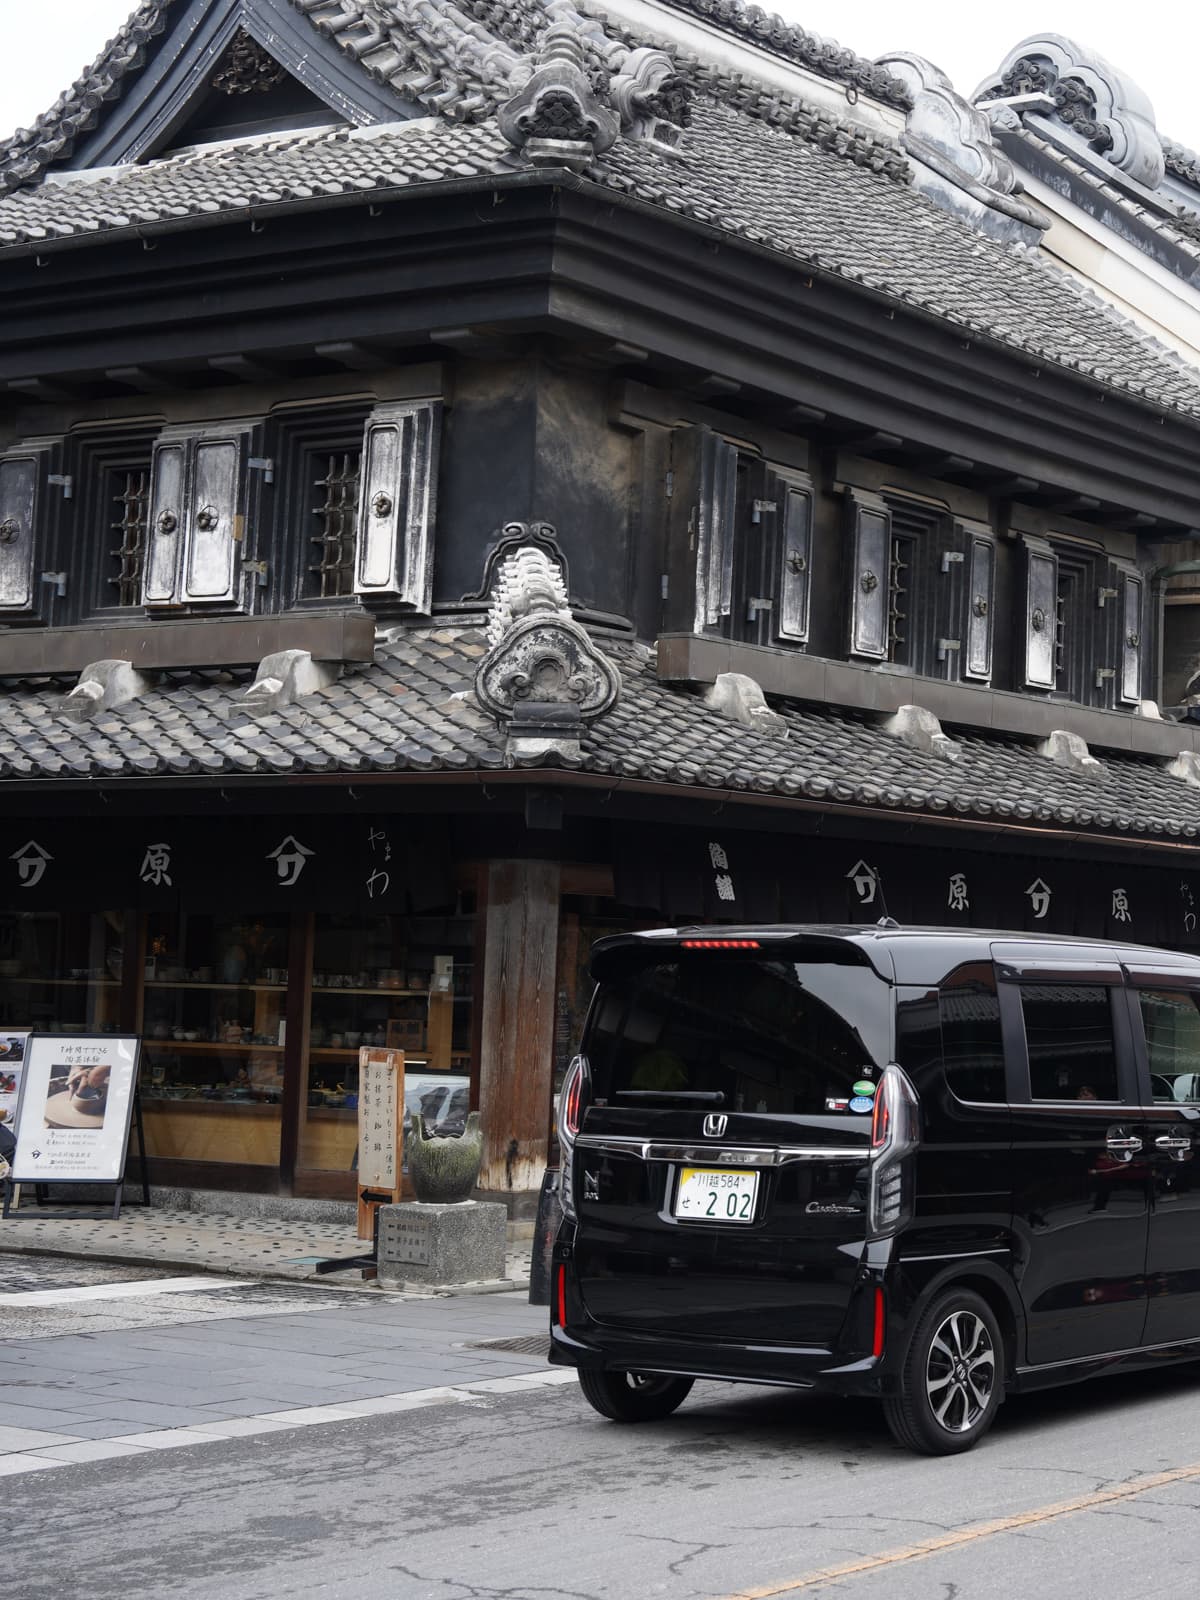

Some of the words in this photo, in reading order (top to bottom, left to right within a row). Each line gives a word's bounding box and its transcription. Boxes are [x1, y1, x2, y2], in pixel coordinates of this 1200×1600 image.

[139, 843, 173, 887] 原
[948, 873, 970, 912] 原
[1112, 888, 1133, 923] 原
[698, 1175, 719, 1188] 川越
[720, 1174, 740, 1189] 584
[682, 1196, 691, 1209] せ
